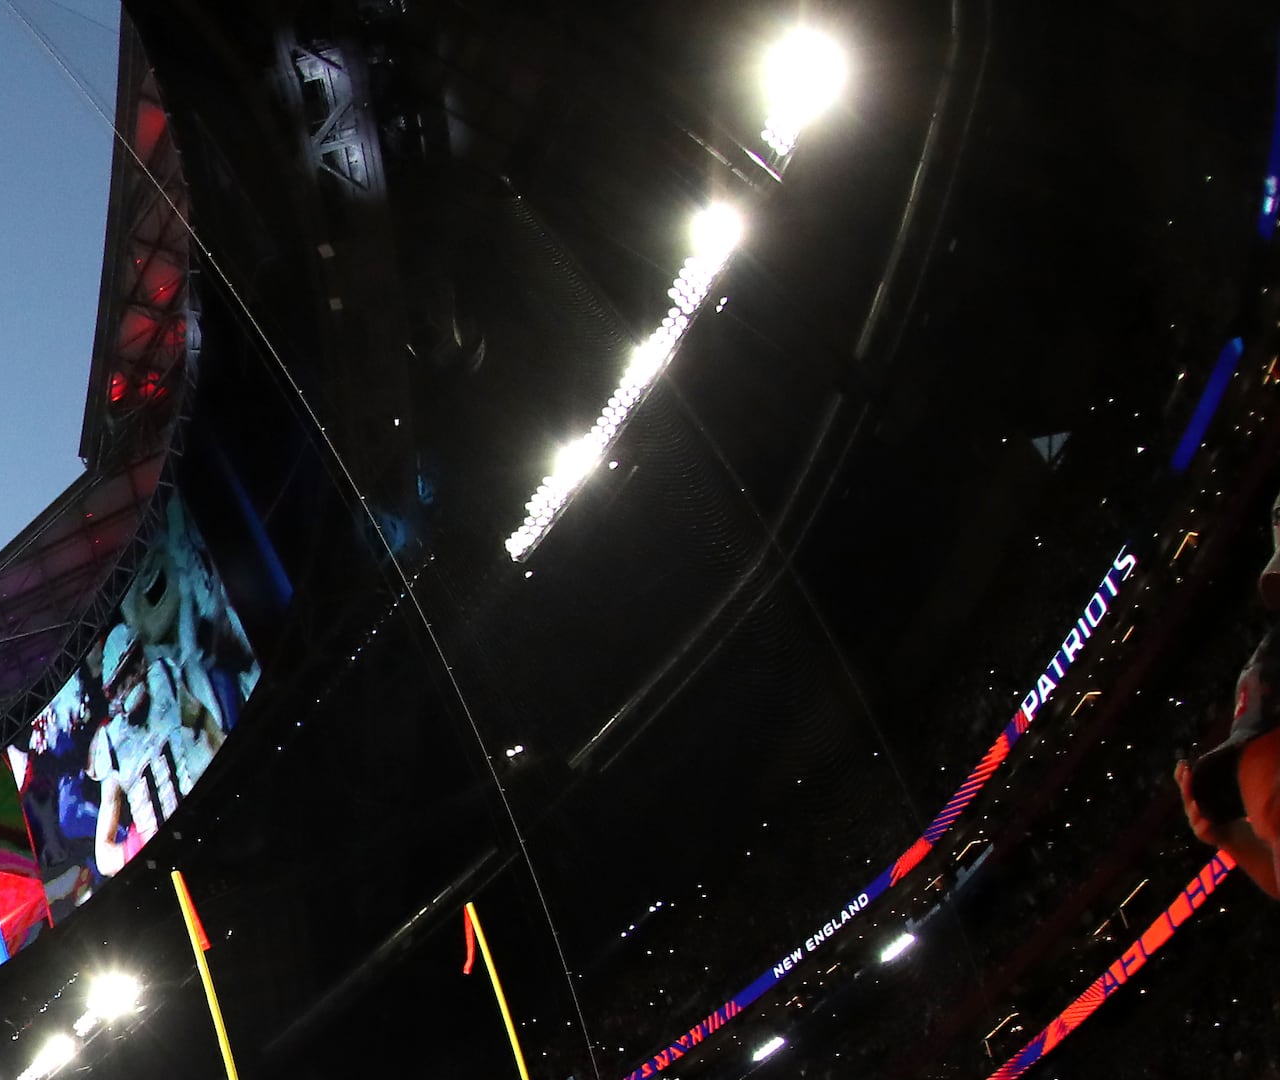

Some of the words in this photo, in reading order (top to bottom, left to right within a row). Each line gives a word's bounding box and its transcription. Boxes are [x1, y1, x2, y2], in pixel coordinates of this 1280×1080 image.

[1020, 545, 1137, 722] PATRIOTS
[773, 946, 804, 979] NEW
[805, 892, 870, 953] ENGLAND
